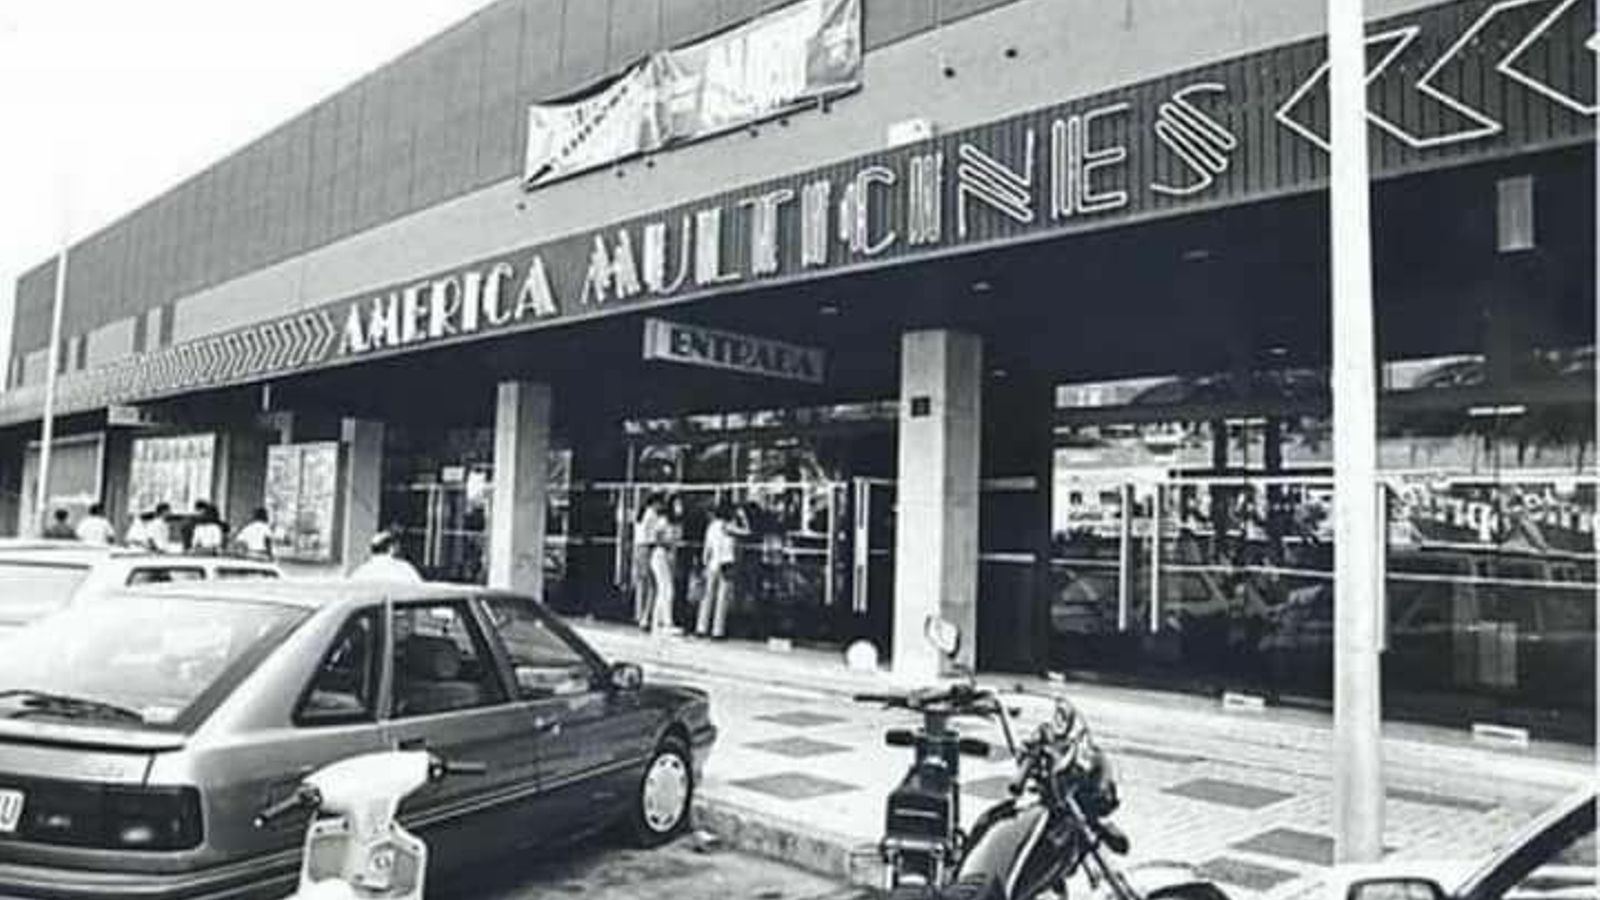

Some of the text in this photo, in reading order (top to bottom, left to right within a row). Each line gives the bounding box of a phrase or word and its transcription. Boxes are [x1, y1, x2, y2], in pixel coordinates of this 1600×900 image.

[339, 254, 557, 356] AMERICA
[581, 83, 1238, 303] MULTICINES
[670, 327, 822, 379] ENTRADA
